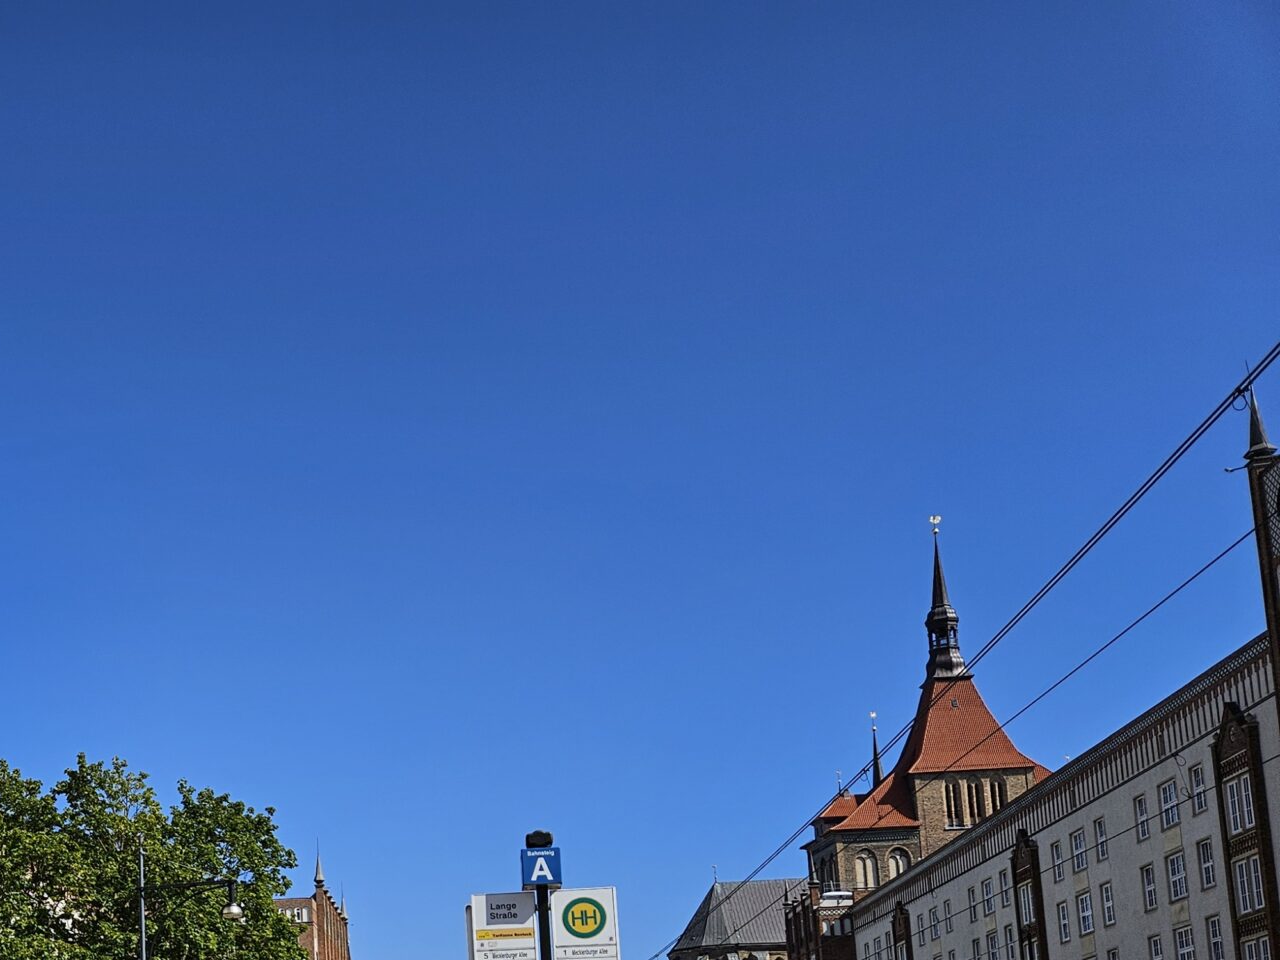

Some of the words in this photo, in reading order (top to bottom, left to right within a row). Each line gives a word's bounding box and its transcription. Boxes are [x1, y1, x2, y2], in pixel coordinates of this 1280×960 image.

[530, 857, 554, 881] A
[490, 902, 517, 911] Lange
[489, 911, 518, 920] Straße
